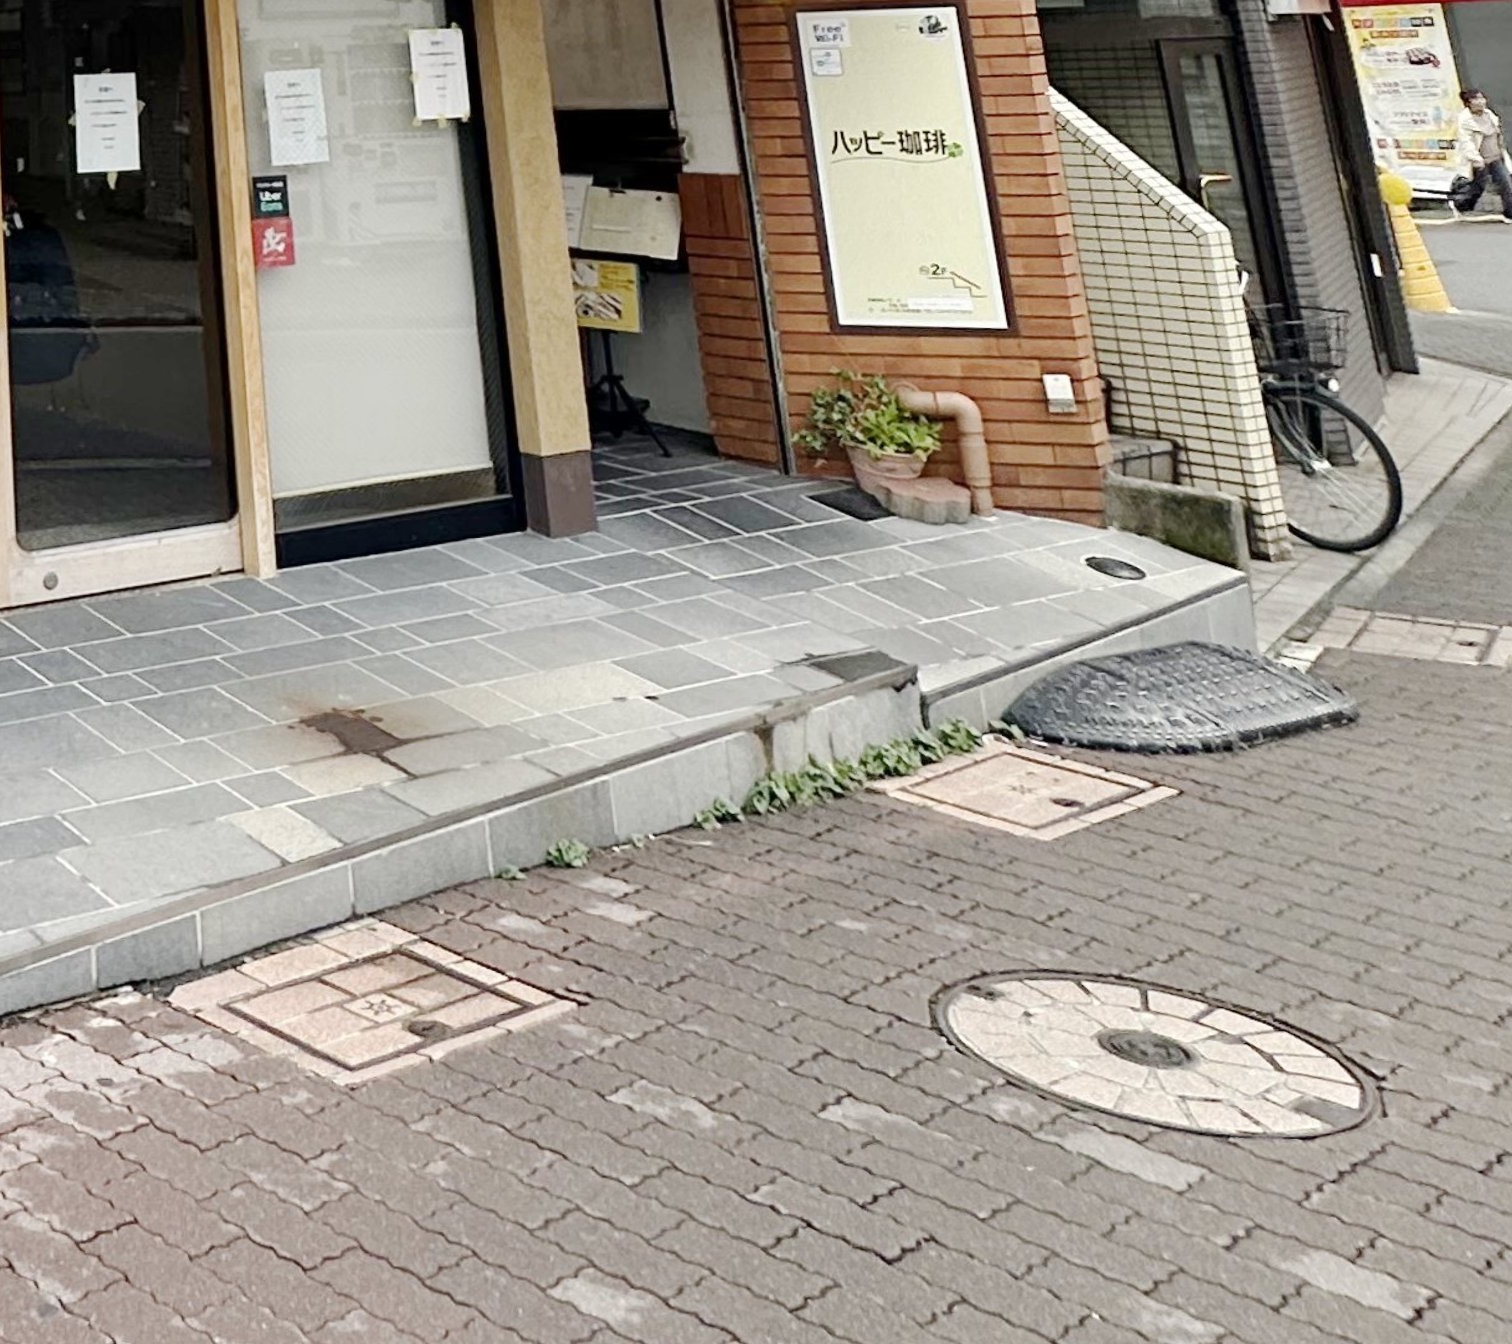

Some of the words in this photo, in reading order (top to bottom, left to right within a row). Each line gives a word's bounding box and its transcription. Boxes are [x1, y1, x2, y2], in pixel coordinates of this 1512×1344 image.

[831, 129, 947, 155] ハッピー珈琲
